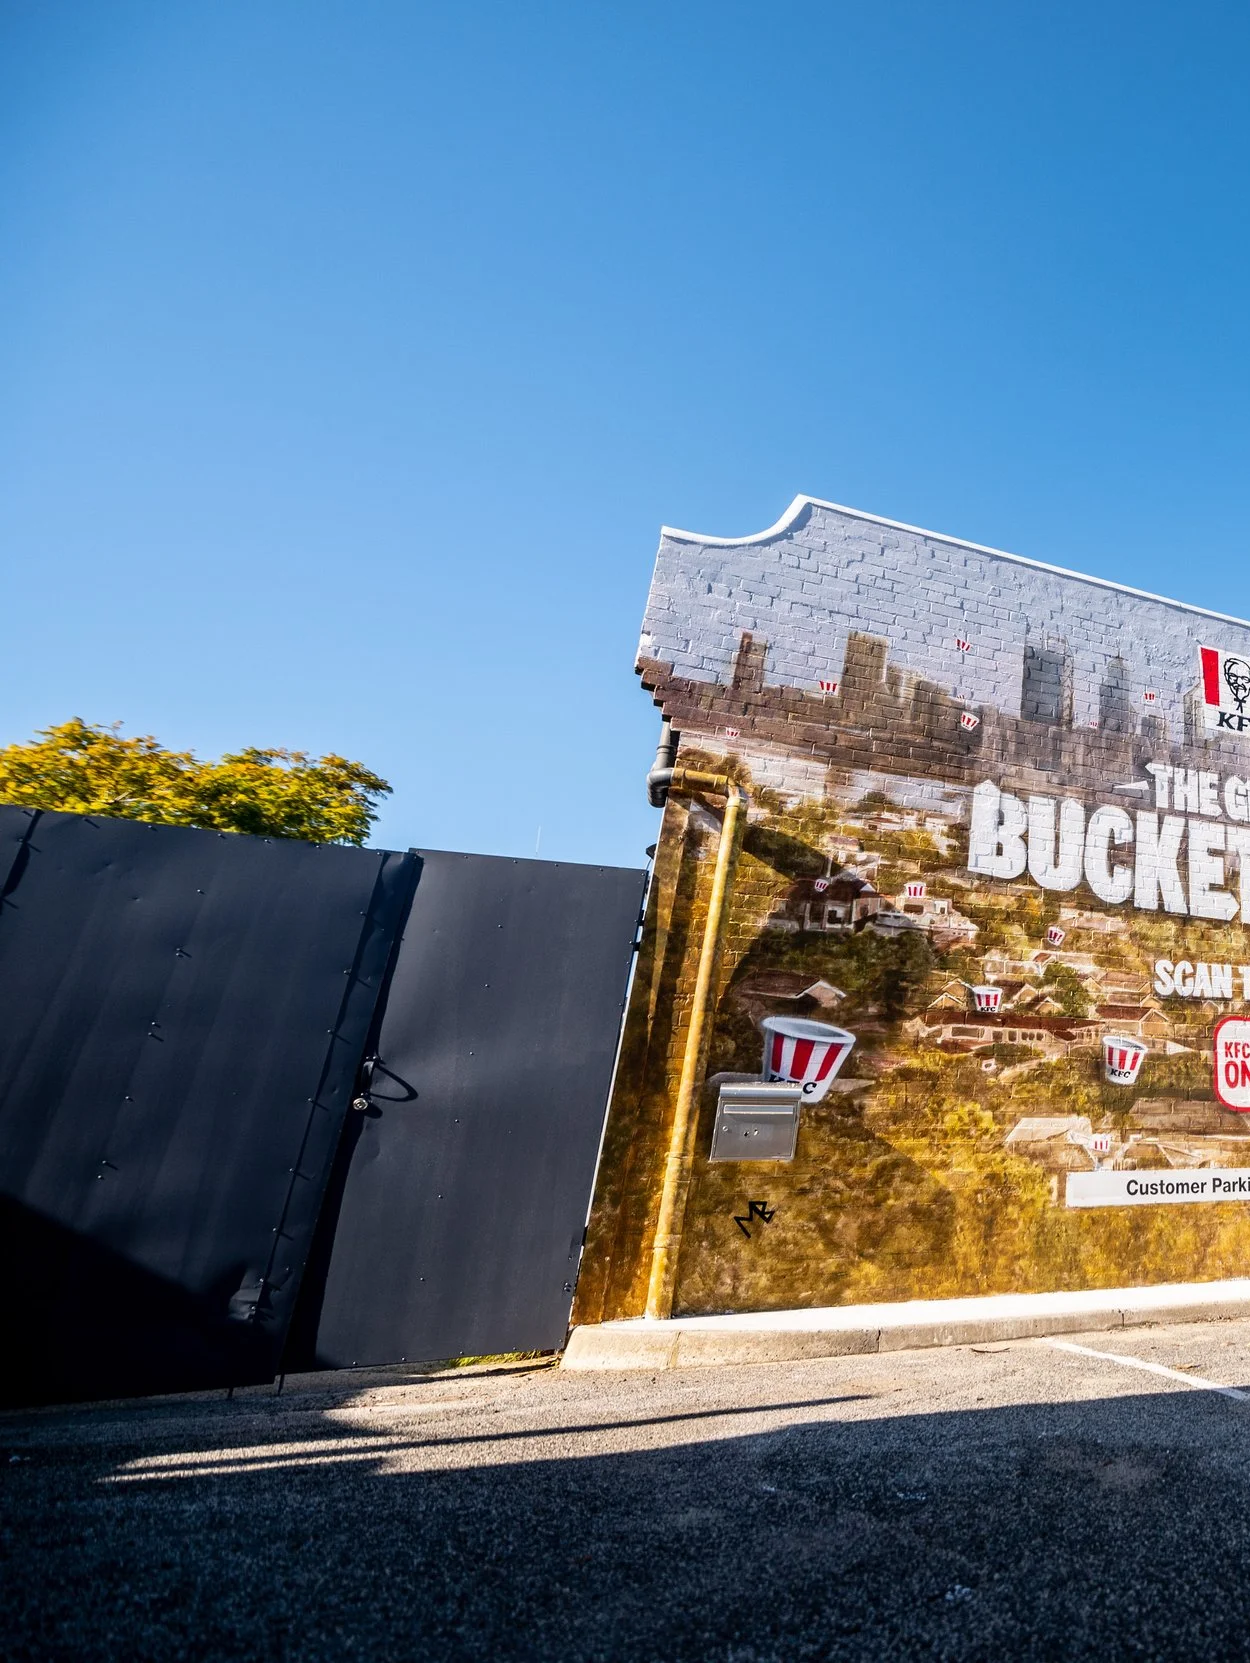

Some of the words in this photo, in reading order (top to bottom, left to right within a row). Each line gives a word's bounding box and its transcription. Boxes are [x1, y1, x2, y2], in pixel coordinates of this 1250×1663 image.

[1145, 762, 1223, 818] THE
[1153, 959, 1233, 999] SCAN
[1224, 1041, 1250, 1059] KFC
[1110, 1068, 1131, 1079] KFC
[1126, 1179, 1207, 1196] Customer
